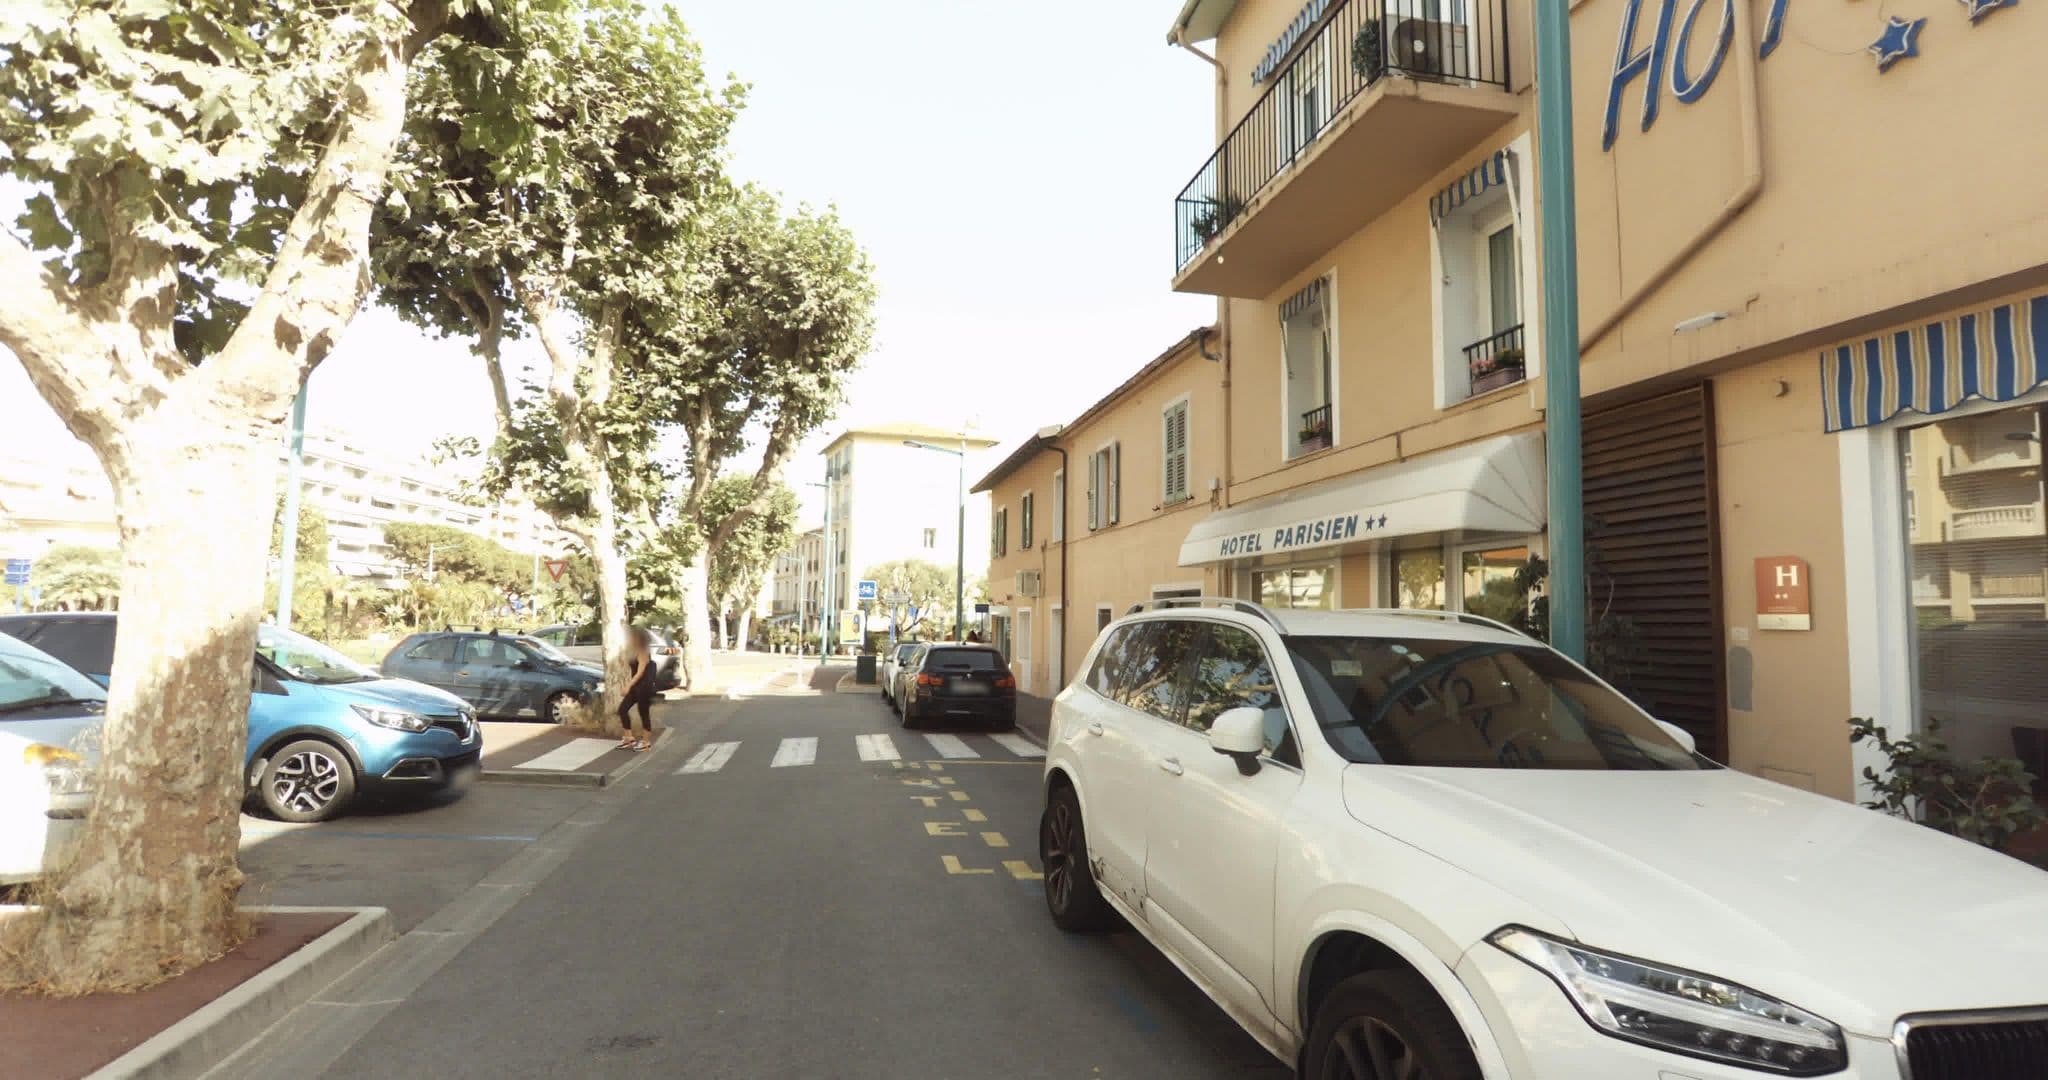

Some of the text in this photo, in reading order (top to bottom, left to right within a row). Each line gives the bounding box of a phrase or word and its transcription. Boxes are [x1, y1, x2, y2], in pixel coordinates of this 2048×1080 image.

[1220, 515, 1358, 556] HOTEL PARISIEN
[1775, 564, 1798, 587] H
